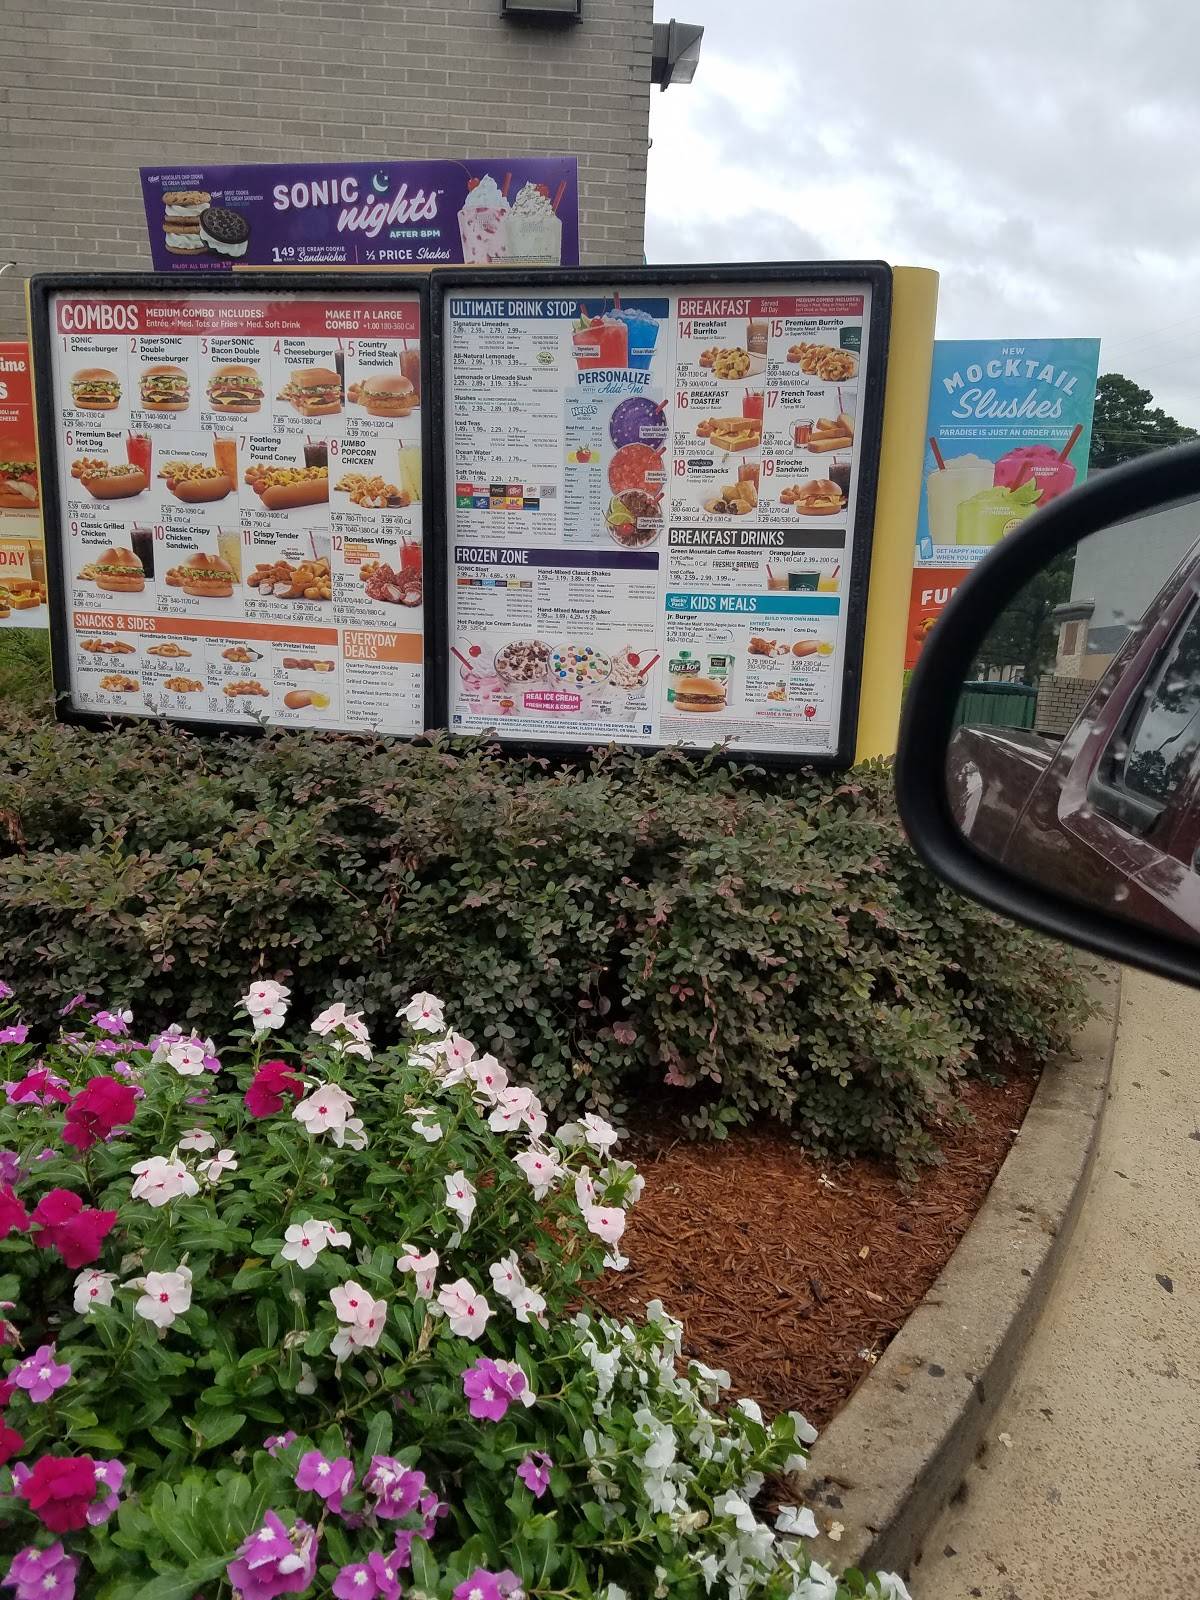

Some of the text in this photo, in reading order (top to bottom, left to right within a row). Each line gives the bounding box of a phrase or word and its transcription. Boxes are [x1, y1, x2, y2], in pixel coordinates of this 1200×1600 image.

[273, 178, 358, 210] SONIC
[337, 183, 438, 238] nights
[390, 230, 440, 239] AFTER 8PM
[297, 251, 347, 262] Sandwiches
[380, 248, 450, 260] PRICE Shakes
[146, 309, 264, 318] MEDIUM COMBO INCLUDES:
[452, 301, 576, 316] ULTIMATE DRINK STOP
[680, 300, 751, 315] BREAKFAST
[61, 305, 138, 330] COMBOS
[325, 311, 402, 320] MAKE IT A LARGE
[177, 320, 193, 328] Med.
[246, 320, 263, 328] Med.
[265, 320, 280, 328] Soft
[325, 321, 359, 329] COMBO
[679, 322, 691, 339] 14
[771, 320, 783, 337] 15
[71, 345, 118, 353] Cheeseburger
[130, 338, 137, 353] 2
[201, 338, 207, 354] 3
[273, 340, 280, 355] 4
[348, 341, 387, 357] 5 Country
[1002, 347, 1025, 355] NEW
[141, 355, 189, 363] Cheeseburger
[211, 356, 260, 364] Cheeseburger
[284, 349, 333, 357] Cheeseburger
[358, 350, 376, 358] Fried
[0, 358, 26, 372] ime
[358, 359, 393, 367] Sandwich
[578, 372, 650, 384] PERSONALIZE
[942, 359, 1079, 396] MOCKTAIL
[598, 384, 643, 394] Add-Ins
[677, 391, 688, 408] 16
[767, 391, 778, 408] 17
[952, 388, 1062, 419] Slushes
[66, 431, 73, 445] 6
[240, 436, 281, 451] 7 Footlong
[330, 440, 338, 455] 8
[674, 460, 685, 476] 18
[762, 460, 774, 476] 19
[71, 522, 78, 536] 9
[154, 526, 164, 540] 10
[189, 527, 210, 536] Crispy
[243, 531, 250, 545] 11
[253, 531, 275, 539] Crispy
[332, 536, 342, 550] 12
[670, 530, 784, 545] BREAKFAST DRINKS
[166, 542, 198, 550] Sandwich
[456, 549, 528, 564] FROZEN ZONE
[712, 561, 759, 569] FRESHLY BREWED
[691, 598, 756, 610] KIDS MEALS
[75, 614, 155, 630] SNACKS & SIDES
[345, 632, 398, 647] EVERYDAY
[345, 646, 377, 658] DEALS
